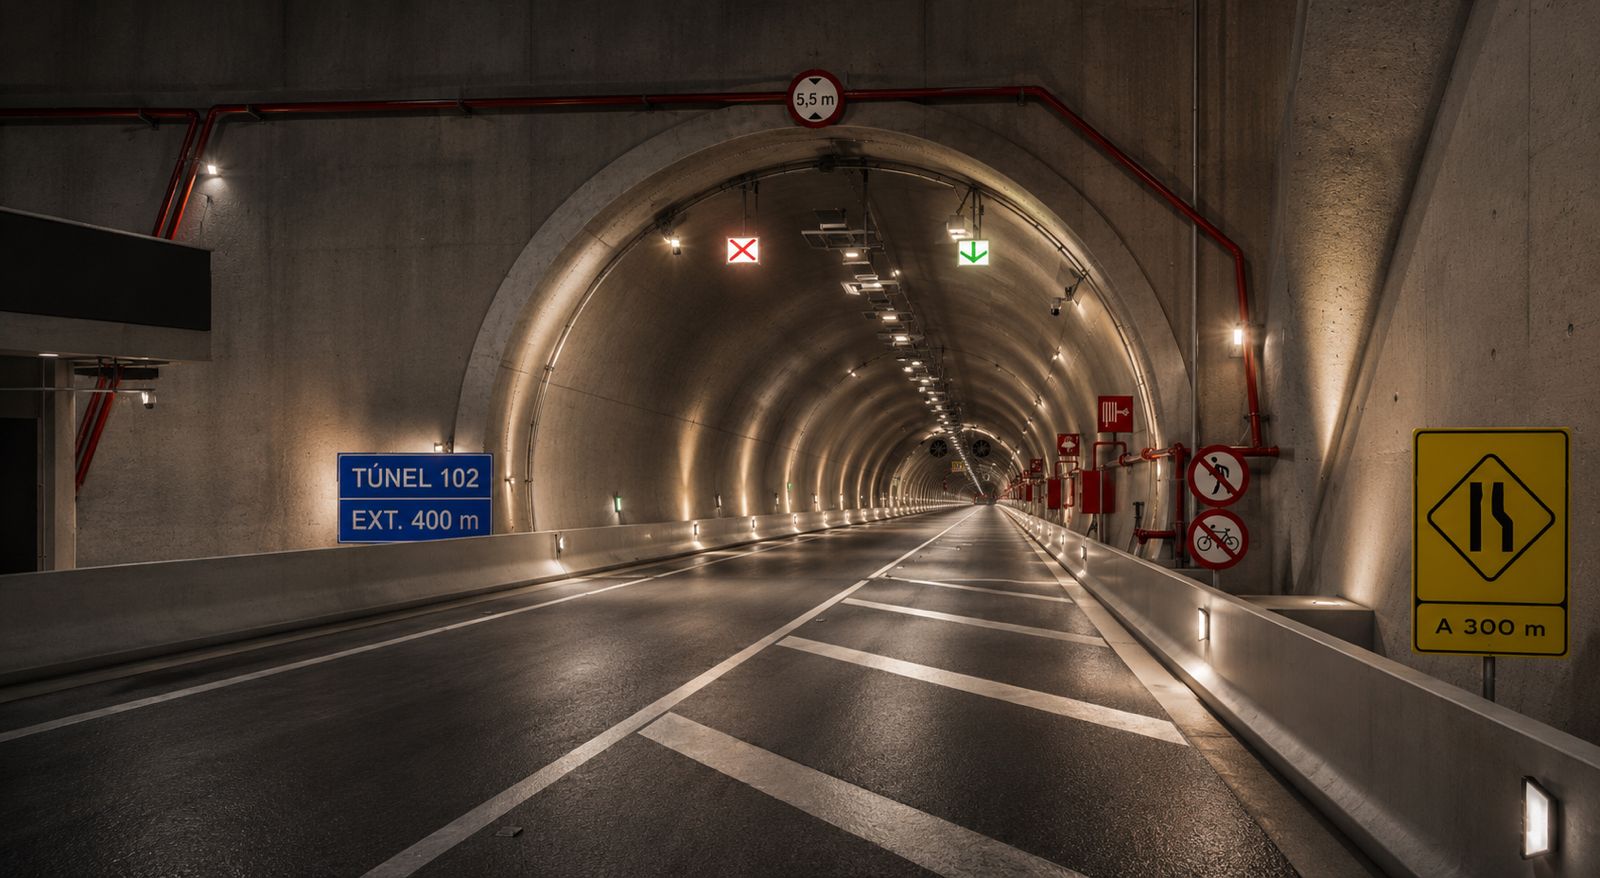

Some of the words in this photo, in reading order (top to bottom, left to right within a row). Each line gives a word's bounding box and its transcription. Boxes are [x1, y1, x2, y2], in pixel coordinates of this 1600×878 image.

[797, 92, 817, 108] 5,5
[821, 95, 834, 106] m
[352, 463, 432, 488] TÚNEL
[441, 468, 479, 488] 102
[352, 510, 402, 530] EXT.
[411, 510, 452, 530] 400
[460, 514, 479, 530] m
[1435, 618, 1453, 634] A
[1464, 618, 1514, 635] 300
[1525, 624, 1545, 637] m
